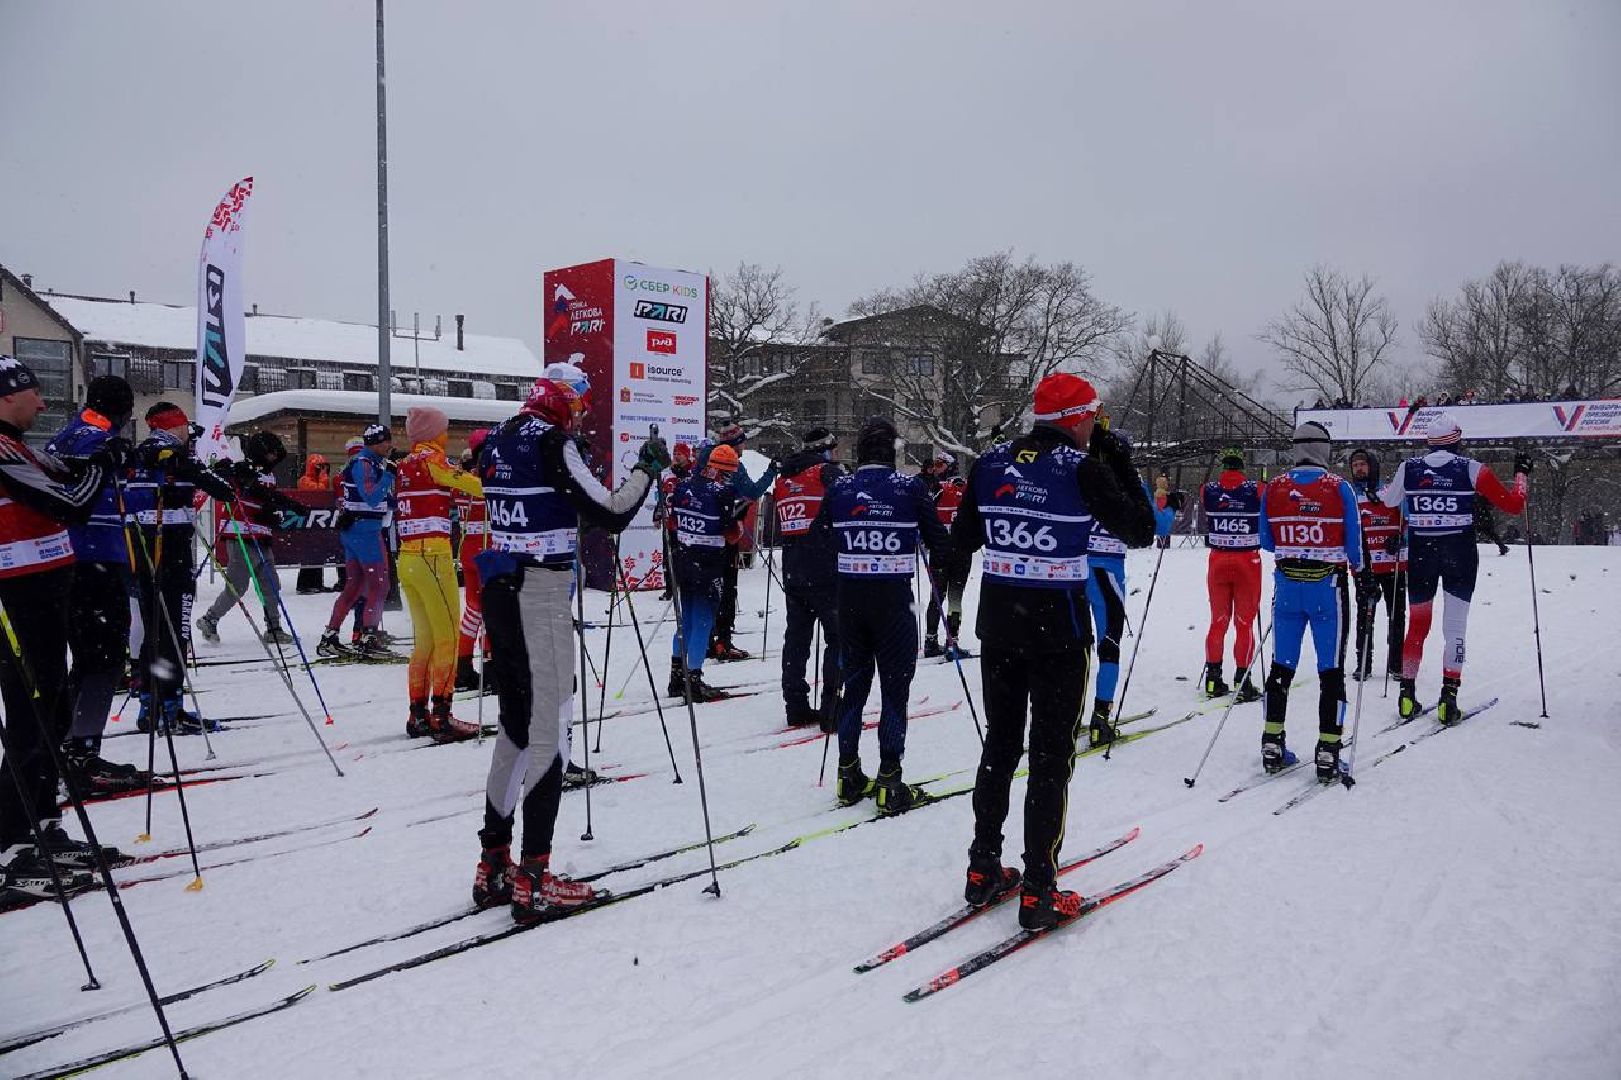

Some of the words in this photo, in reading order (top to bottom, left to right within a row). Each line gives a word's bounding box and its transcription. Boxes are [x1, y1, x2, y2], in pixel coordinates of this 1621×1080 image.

[673, 285, 697, 298] KIDS
[636, 301, 686, 323] PARI
[570, 319, 605, 336] PARI
[778, 502, 806, 521] 1122
[1412, 496, 1458, 512] 1365
[677, 514, 706, 534] 1432
[1213, 518, 1250, 534] 1465
[843, 530, 902, 551] 1486
[985, 518, 1058, 551] 1366
[1279, 524, 1324, 544] 1130
